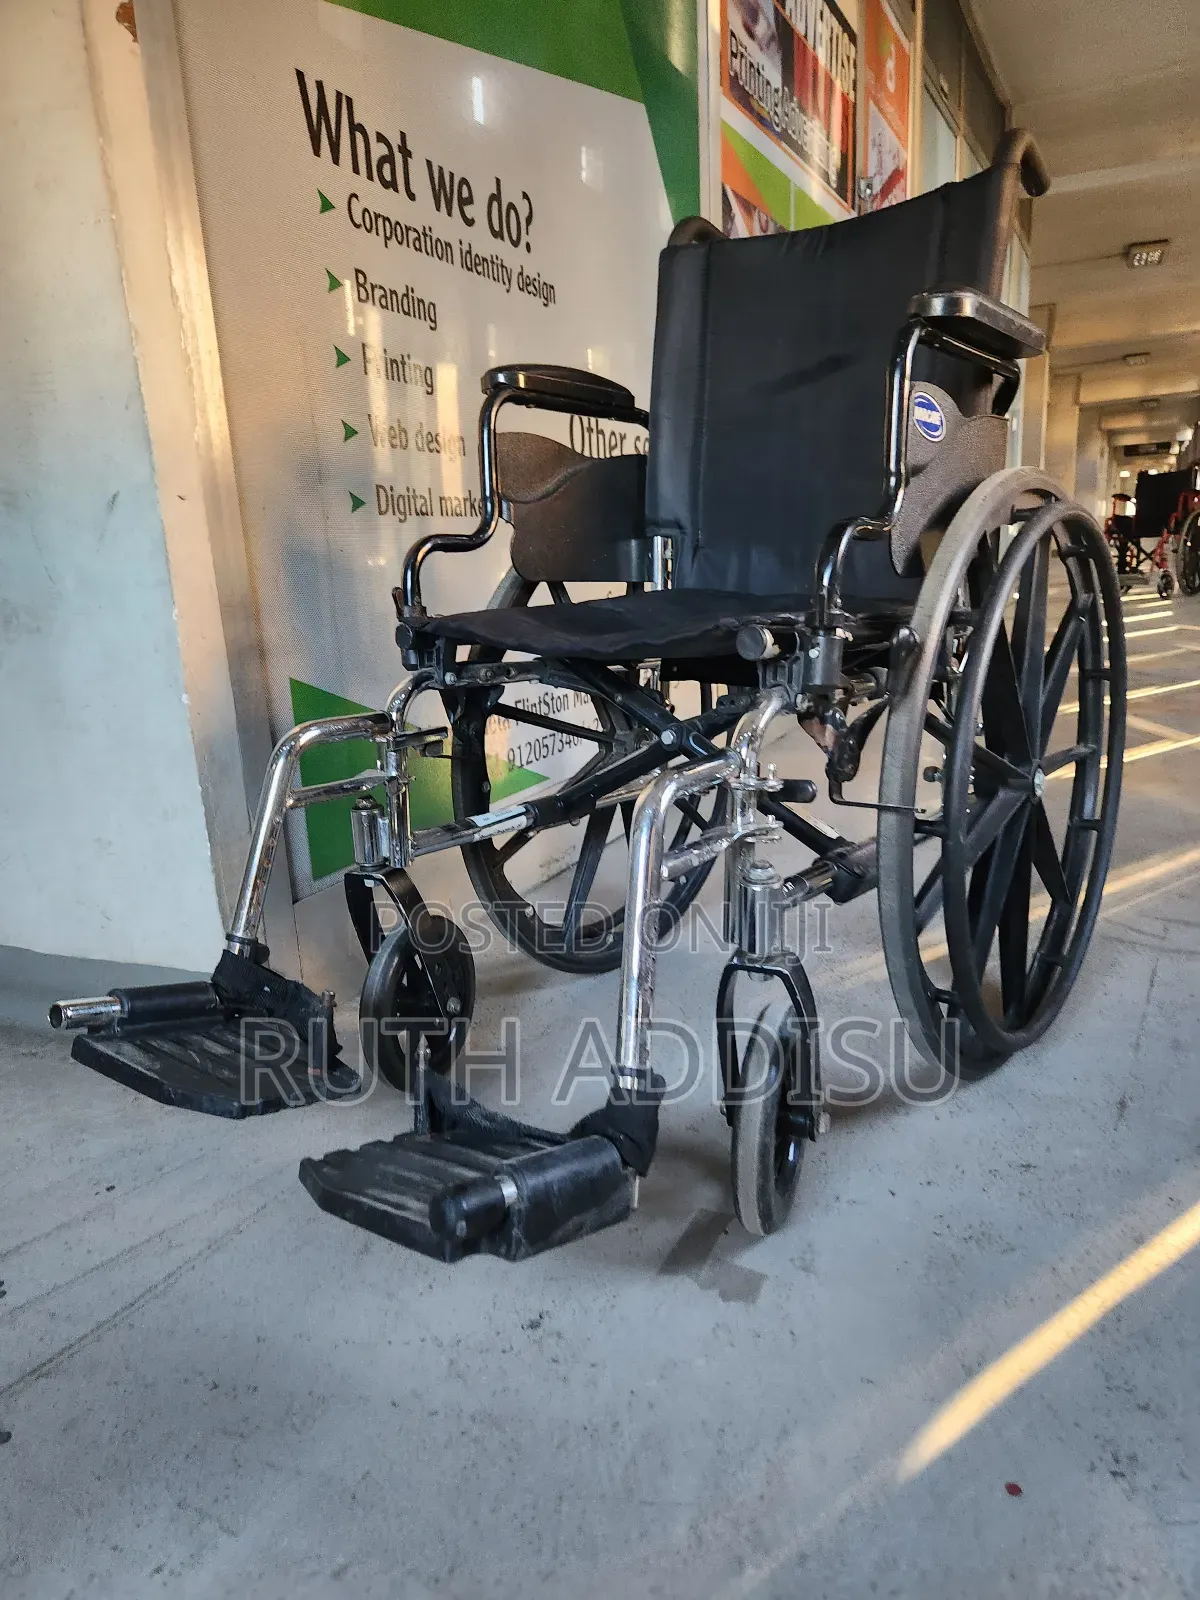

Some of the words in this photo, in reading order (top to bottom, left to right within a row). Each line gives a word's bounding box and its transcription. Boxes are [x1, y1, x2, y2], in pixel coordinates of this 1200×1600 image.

[295, 68, 417, 202] What
[426, 158, 475, 227] we
[487, 177, 534, 254] do?
[347, 192, 454, 267] Corporation
[459, 239, 513, 294] identity
[517, 265, 557, 308] design
[354, 267, 438, 332] Branding
[367, 413, 409, 450] Web
[569, 414, 627, 458] Other
[375, 484, 433, 523] Digital
